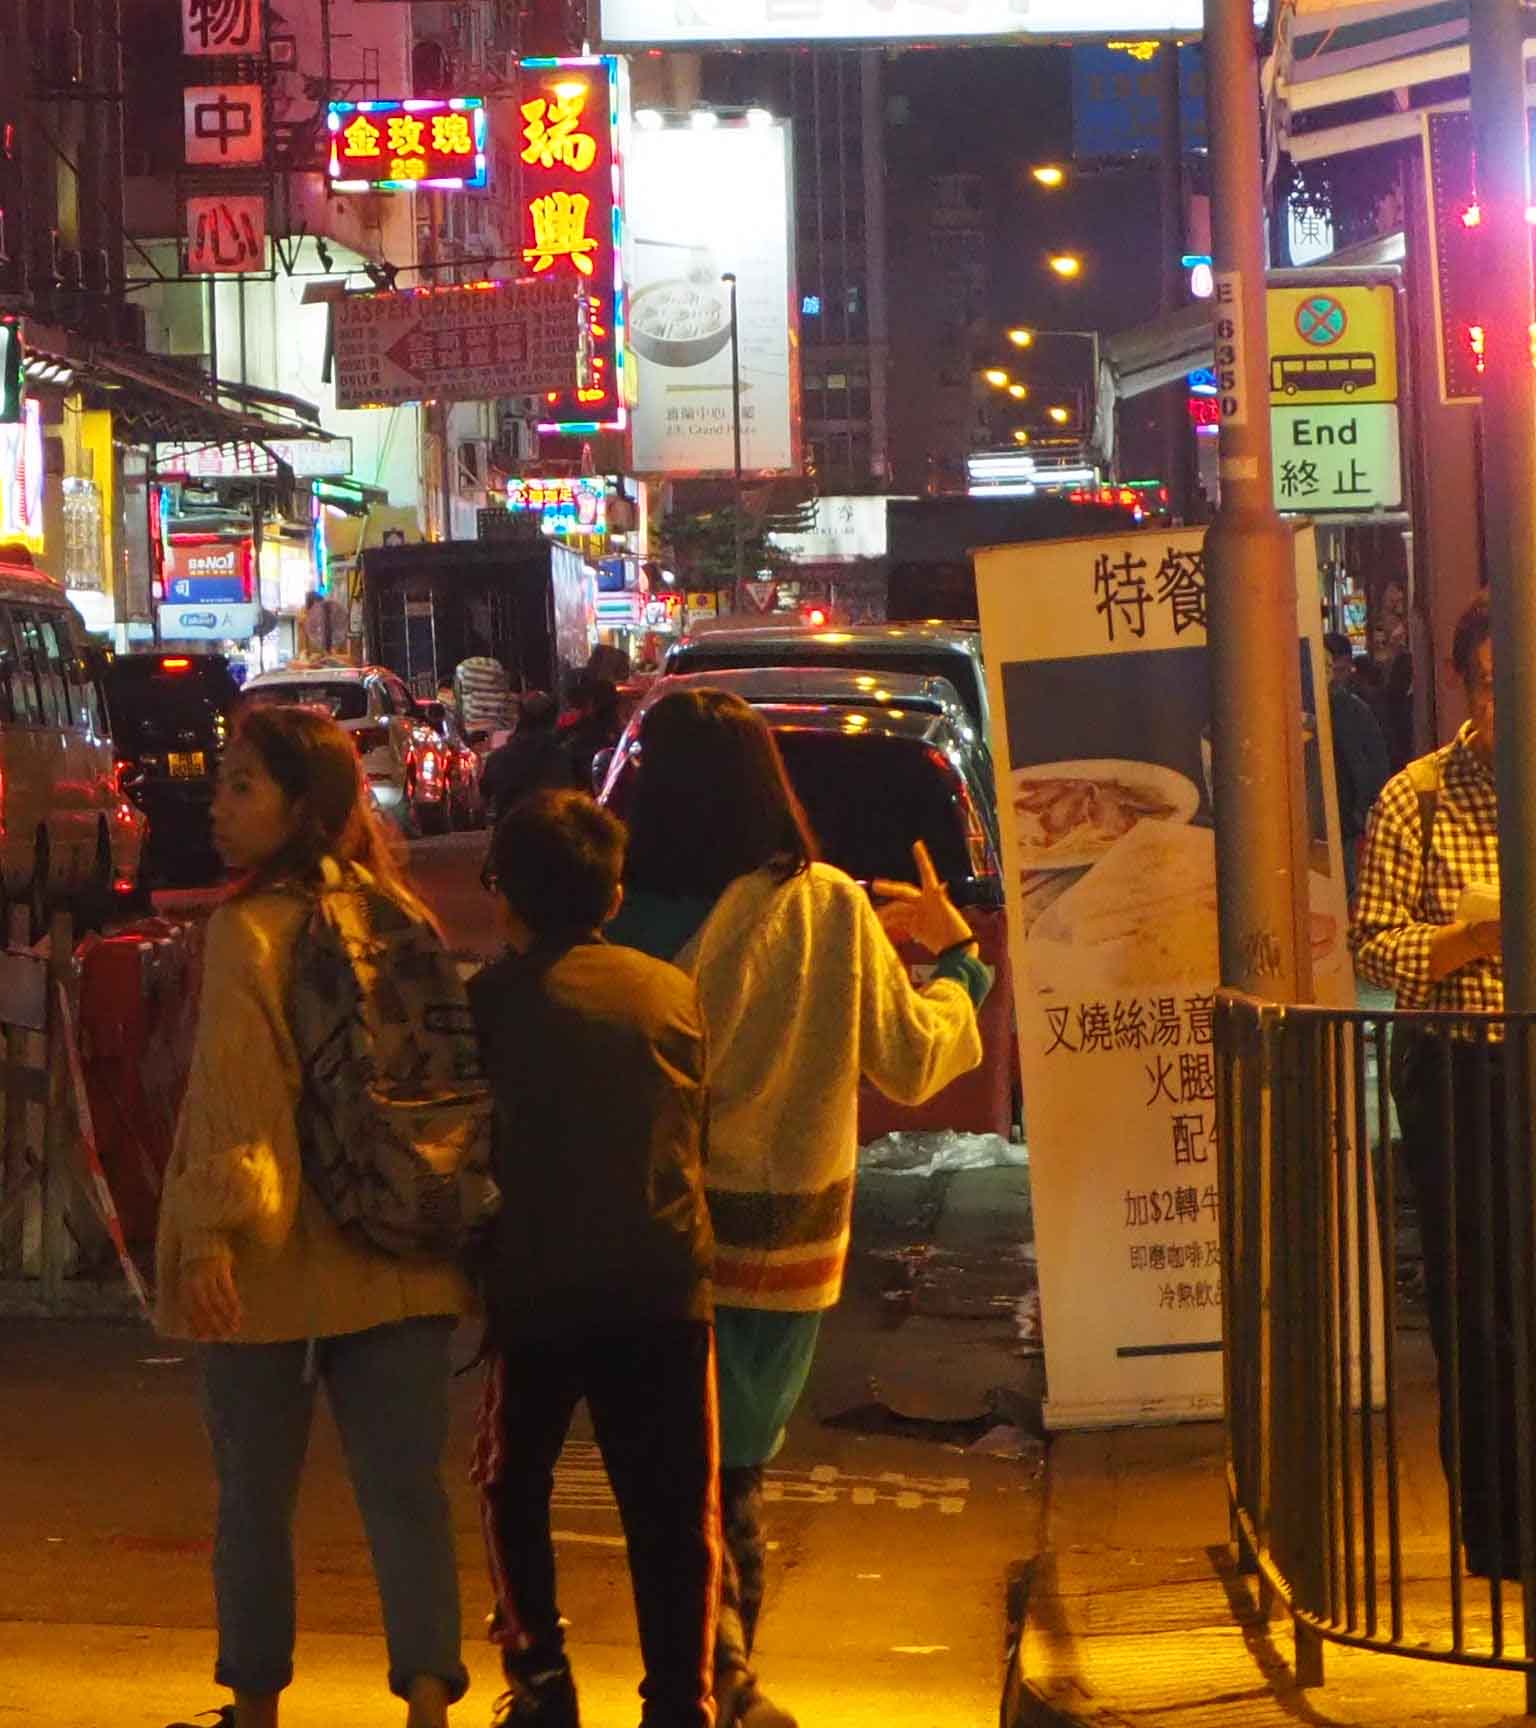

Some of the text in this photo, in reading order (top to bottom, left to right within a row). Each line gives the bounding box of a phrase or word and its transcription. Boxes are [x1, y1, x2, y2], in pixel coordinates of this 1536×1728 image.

[1293, 418, 1358, 446] End
[1280, 459, 1371, 497] 終止
[1094, 547, 1207, 642] 特餐
[1145, 1052, 1215, 1107] 火腿
[1171, 1113, 1219, 1166] 配
